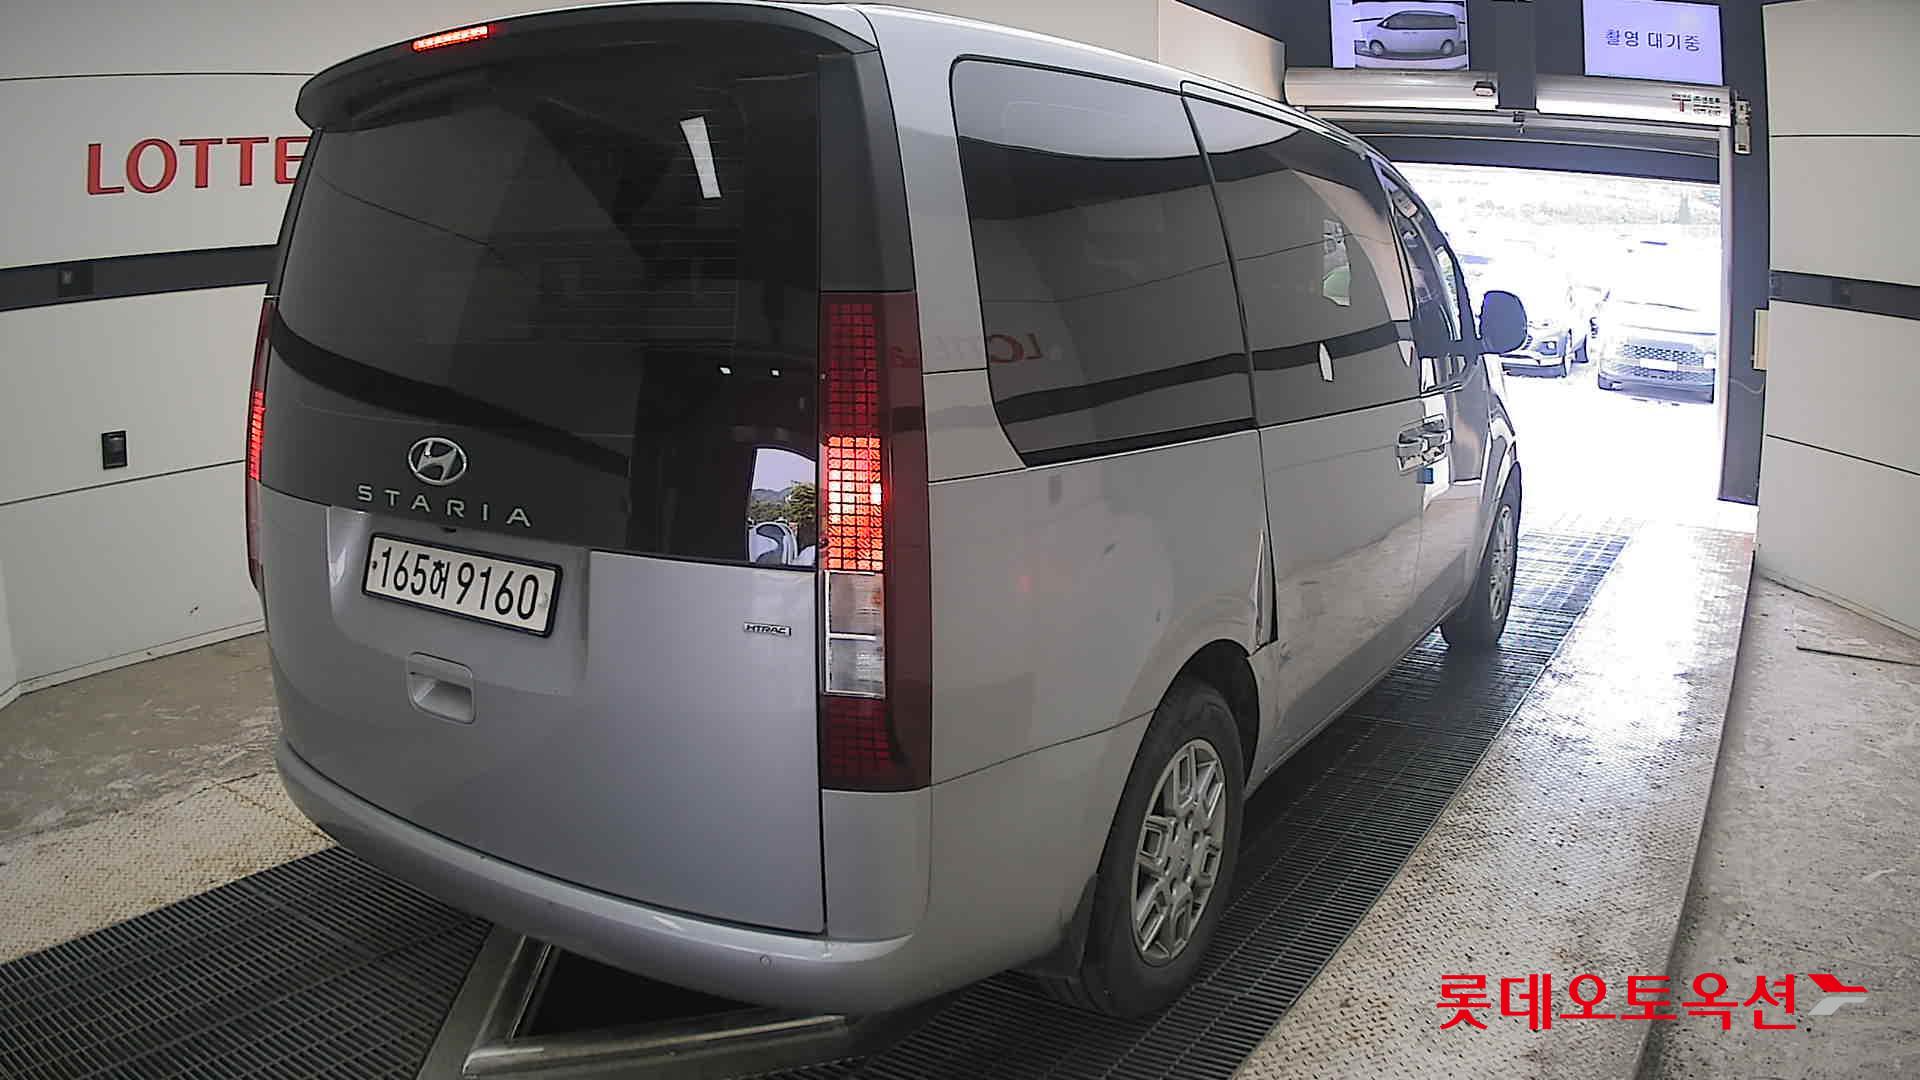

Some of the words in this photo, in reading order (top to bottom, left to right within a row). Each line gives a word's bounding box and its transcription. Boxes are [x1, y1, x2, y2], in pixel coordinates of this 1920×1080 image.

[1607, 29, 1639, 47] 촬영
[1647, 32, 1700, 51] 대기중
[87, 136, 310, 195] LOTTE
[357, 484, 531, 527] STARIA
[744, 622, 792, 637] HTRAC
